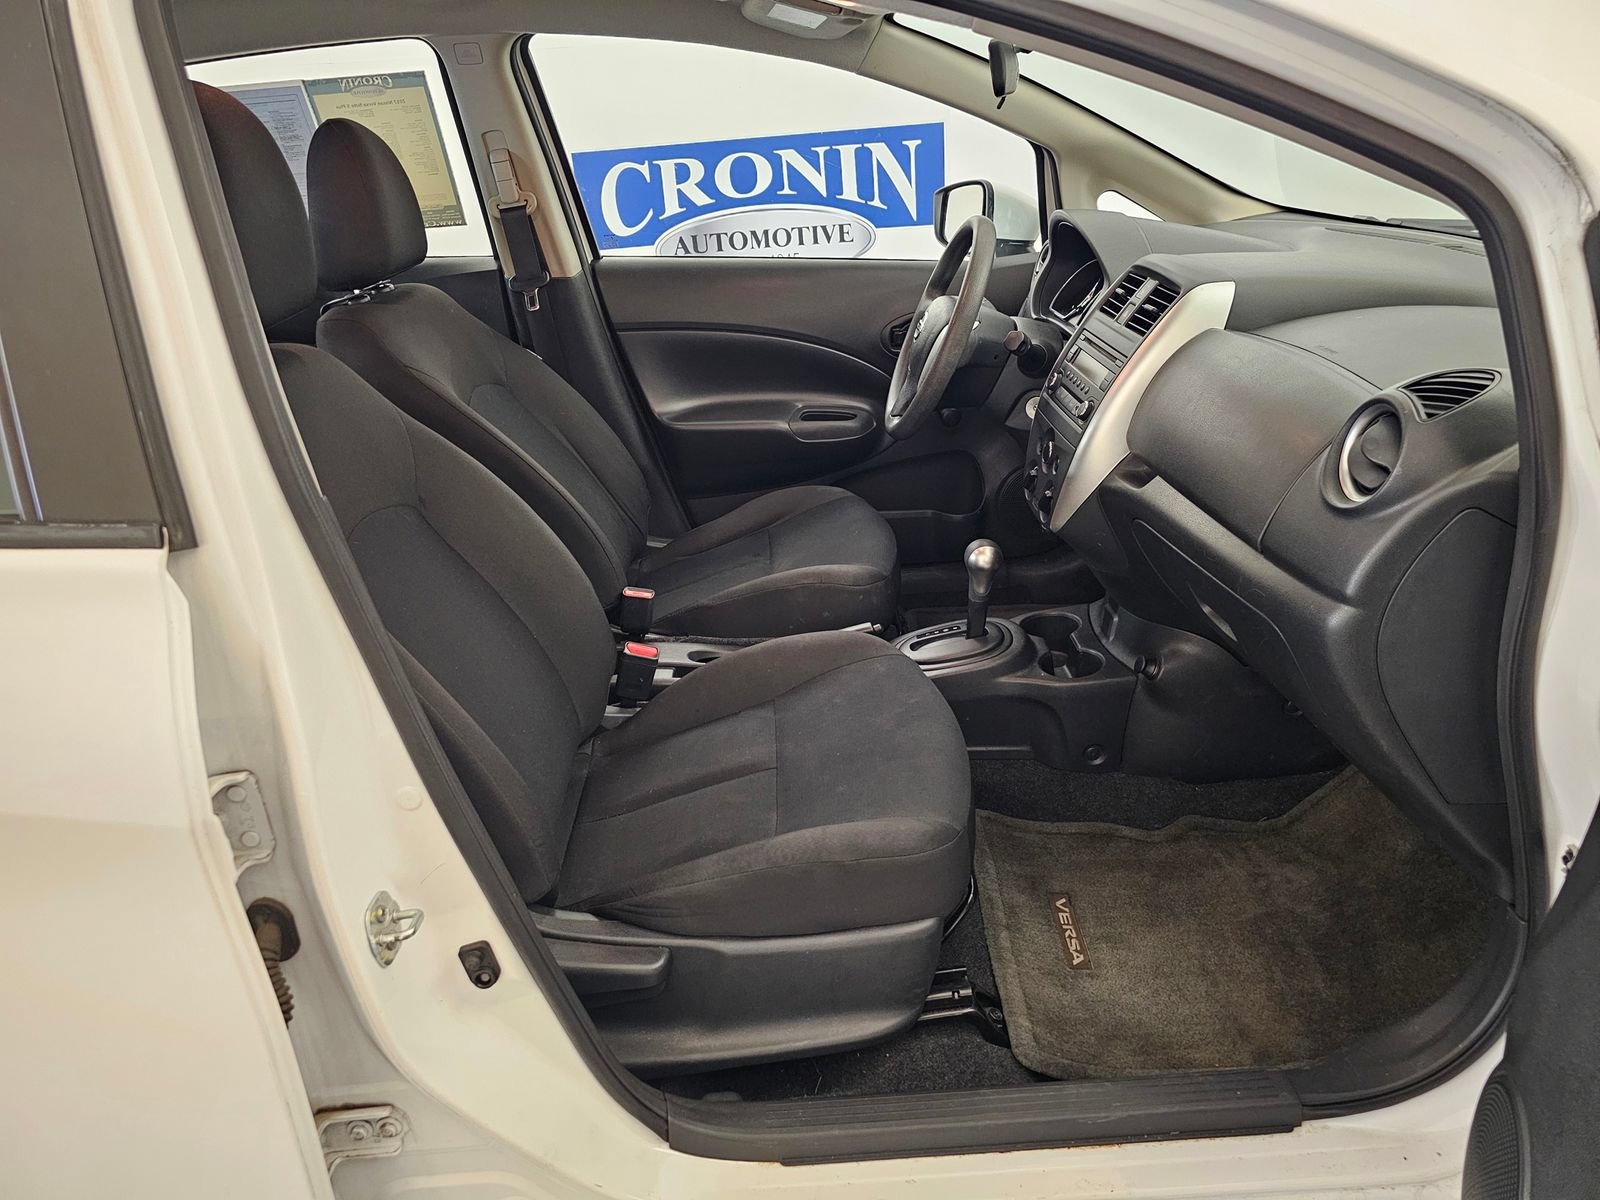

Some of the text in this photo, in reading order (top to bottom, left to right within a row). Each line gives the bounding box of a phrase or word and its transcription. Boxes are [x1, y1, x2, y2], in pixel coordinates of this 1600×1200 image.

[601, 139, 923, 238] CRONIN
[674, 222, 855, 256] AUTOMOTIVE
[1055, 897, 1085, 966] VERSA
